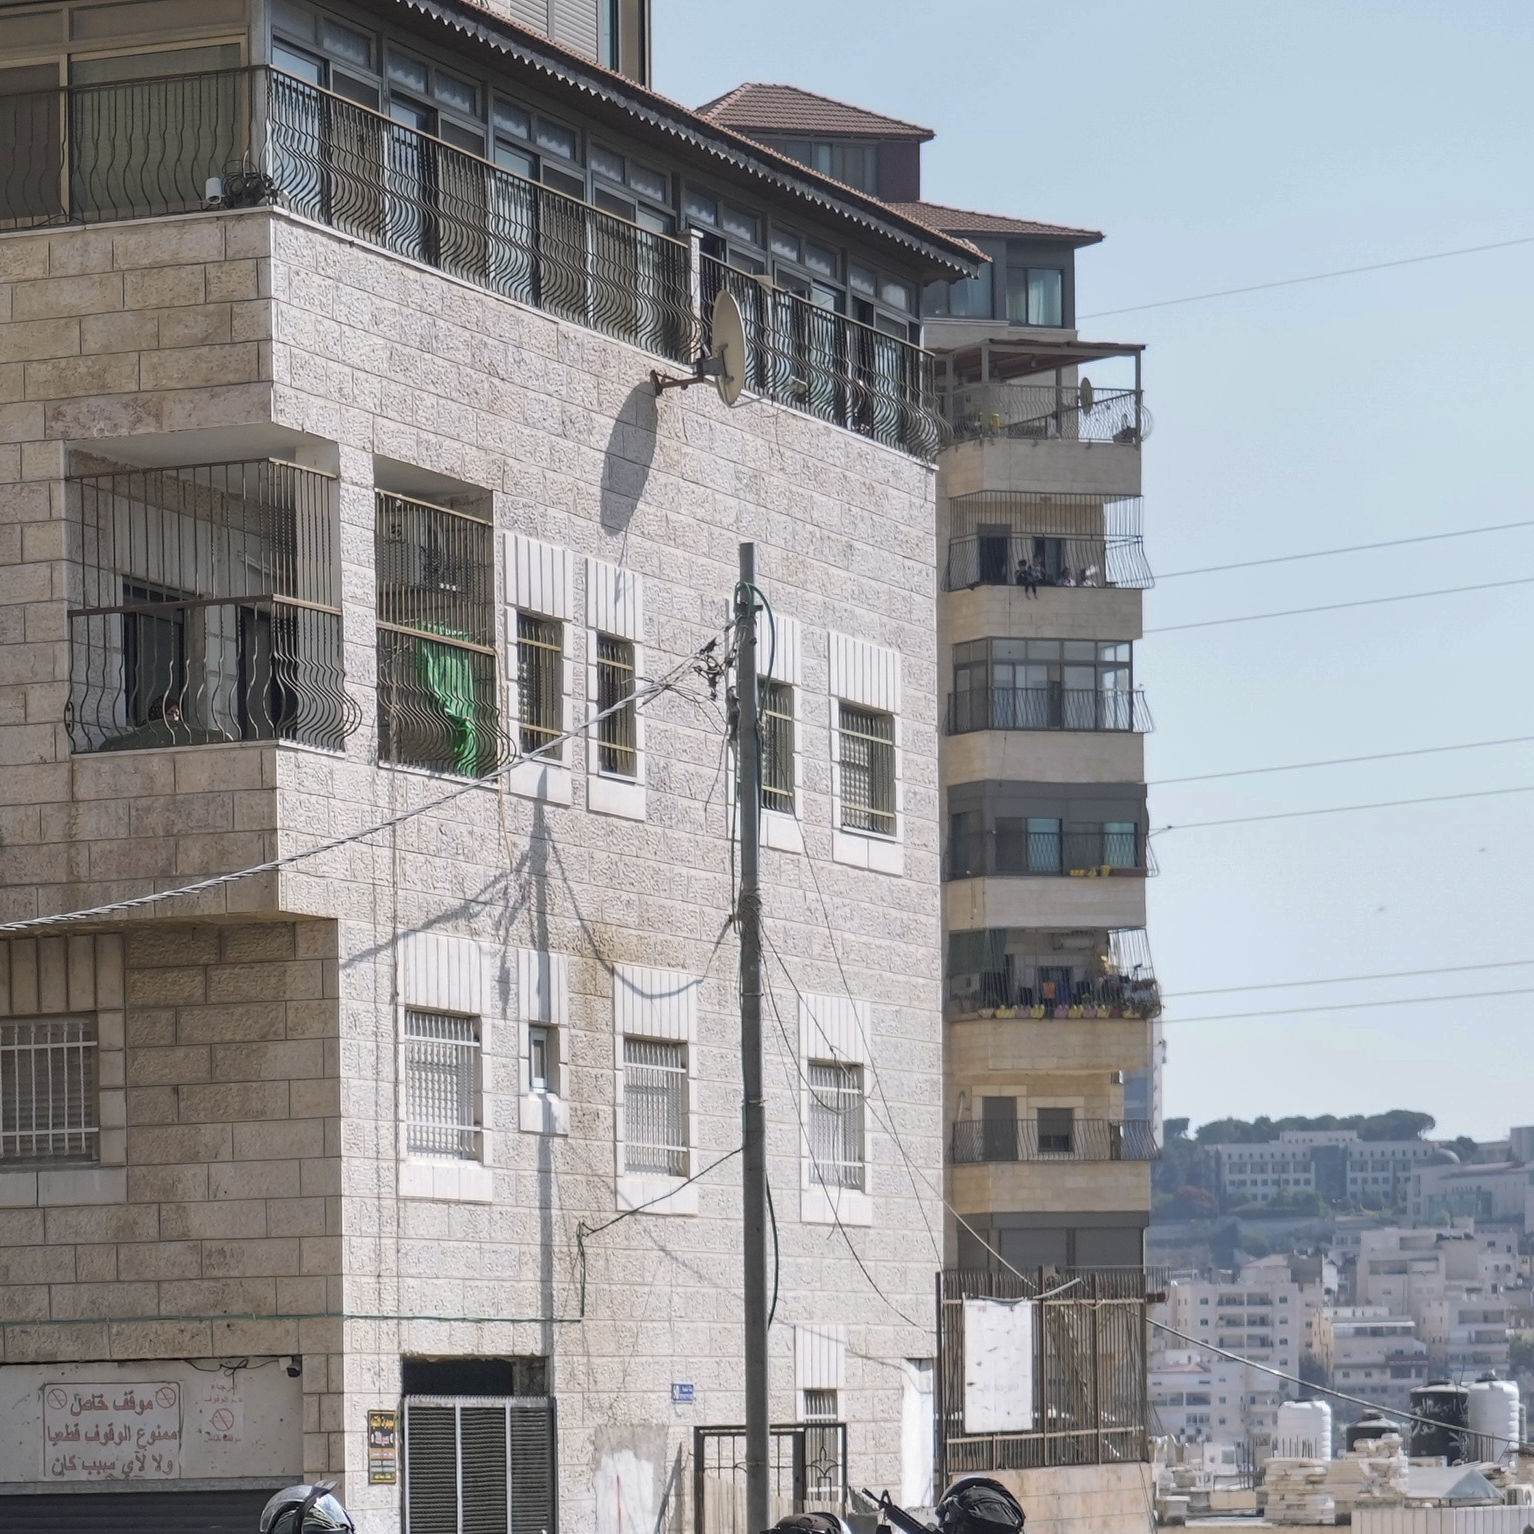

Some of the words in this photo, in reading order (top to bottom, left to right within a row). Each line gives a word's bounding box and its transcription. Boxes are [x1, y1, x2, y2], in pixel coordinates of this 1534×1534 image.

[112, 1389, 154, 1416] موقف
[84, 1422, 131, 1447] الوقوف
[136, 1423, 178, 1450] ممنوع
